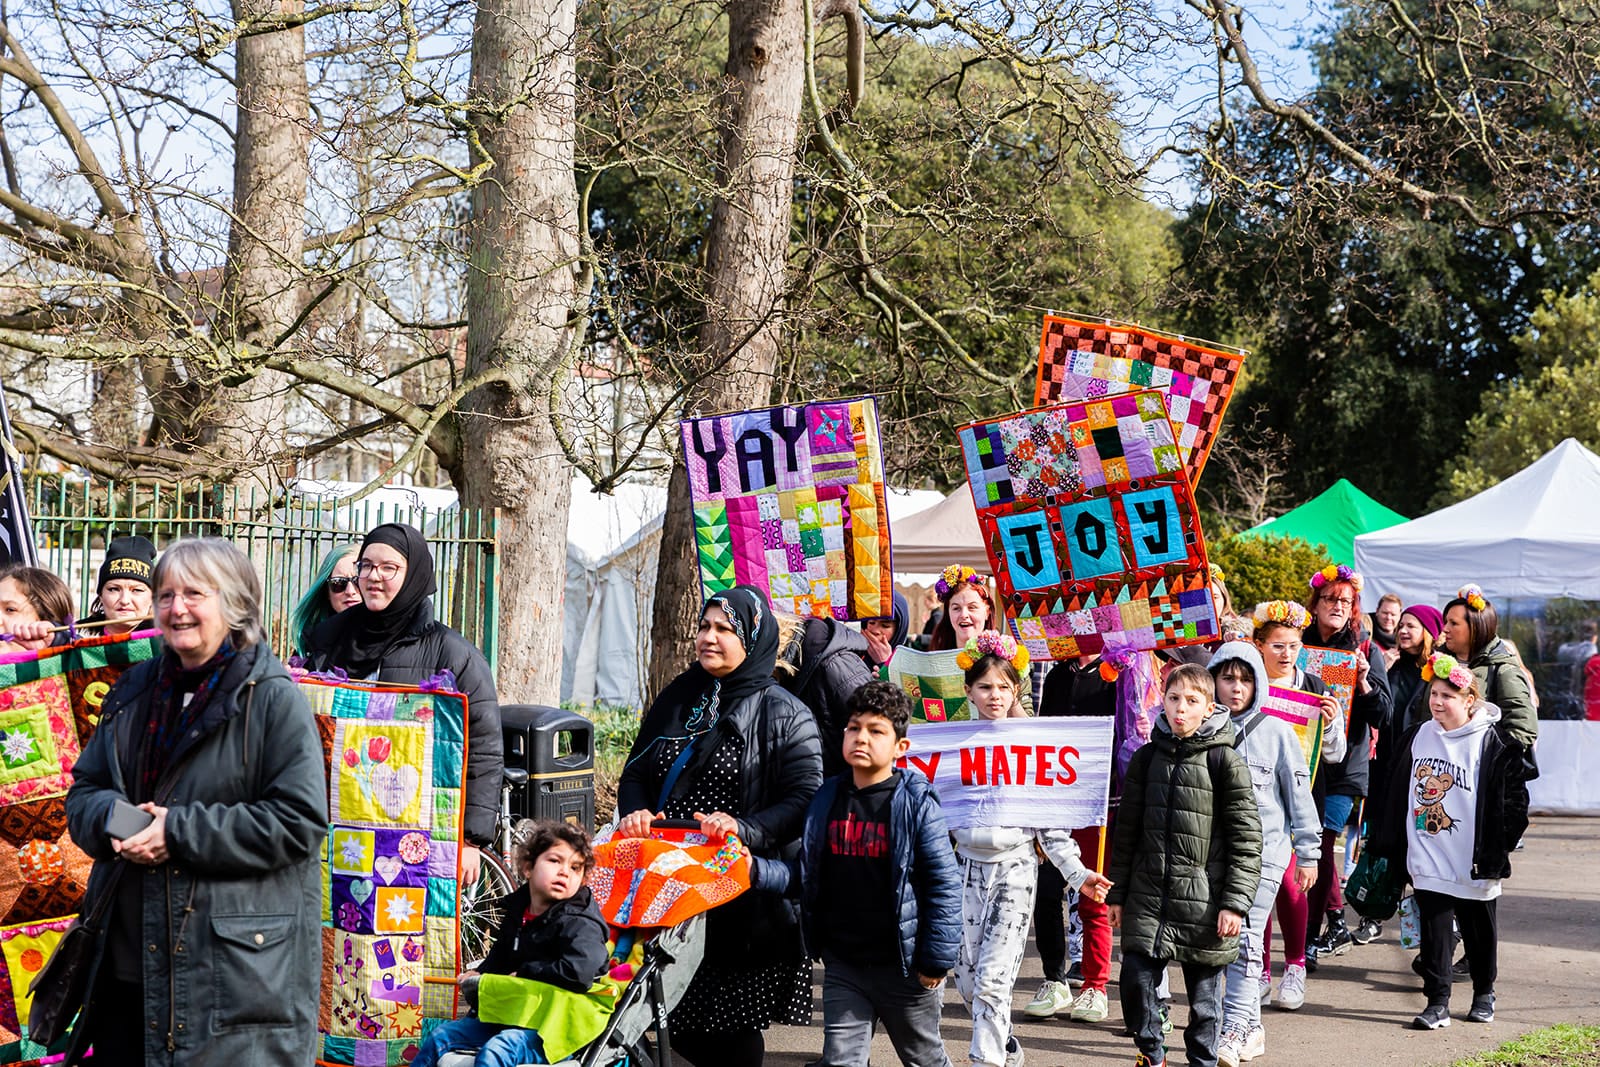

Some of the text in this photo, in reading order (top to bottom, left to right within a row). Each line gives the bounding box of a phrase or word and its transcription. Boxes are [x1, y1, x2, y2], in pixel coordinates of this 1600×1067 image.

[692, 407, 806, 493] YAY
[1009, 499, 1169, 577] JOY
[110, 558, 151, 576] KENT
[560, 780, 583, 790] LITTER
[896, 744, 1080, 787] Y MATES
